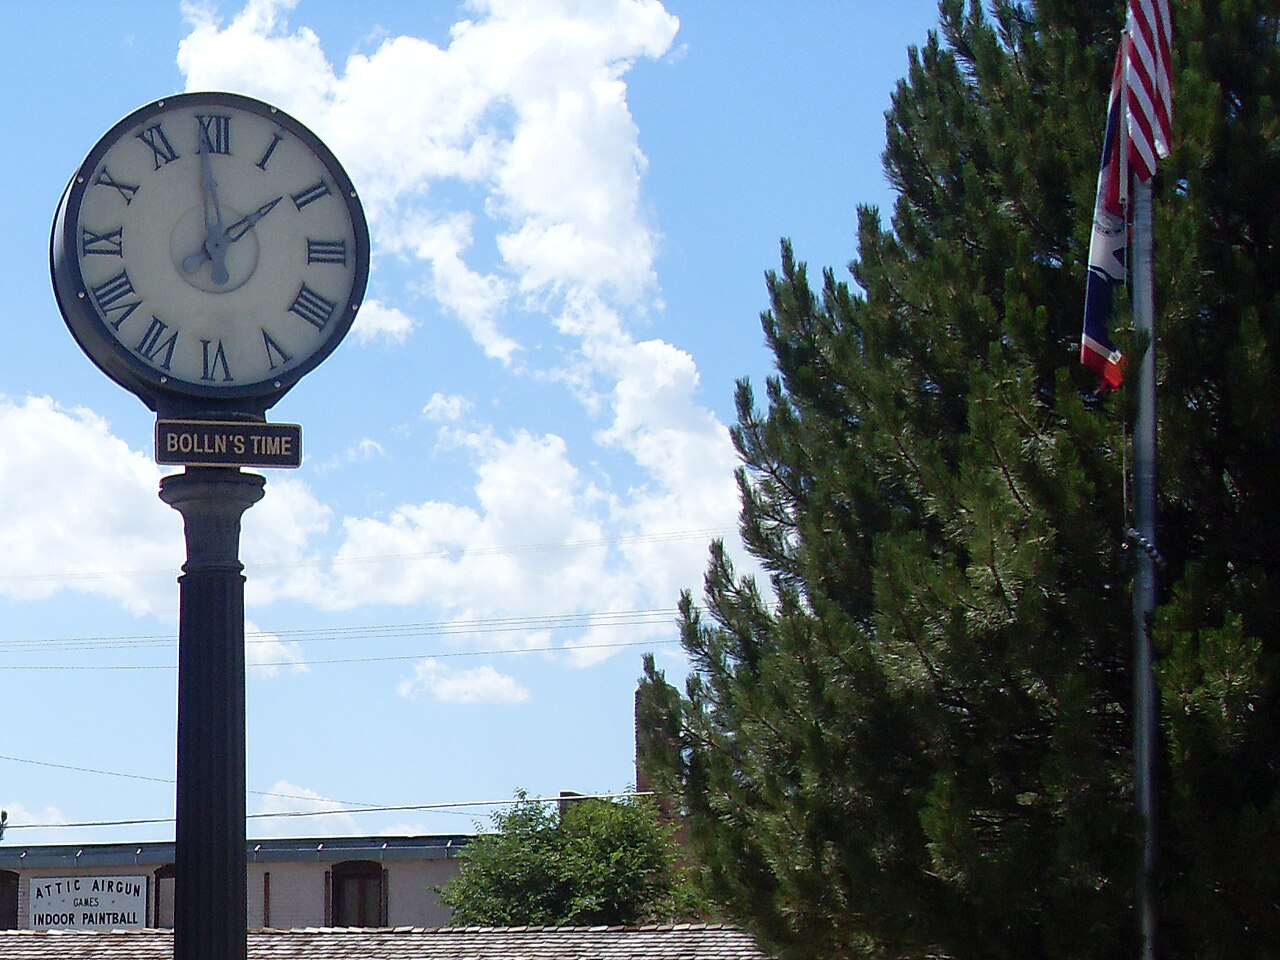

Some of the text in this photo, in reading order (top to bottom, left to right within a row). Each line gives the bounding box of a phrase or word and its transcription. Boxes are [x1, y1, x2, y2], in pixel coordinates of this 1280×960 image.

[136, 123, 180, 171] XI
[194, 114, 232, 156] XII
[256, 133, 284, 171] I
[95, 167, 140, 206] X
[289, 180, 332, 212] II
[82, 226, 123, 259] IX
[306, 238, 346, 267] III
[91, 268, 143, 332] VIII
[288, 282, 338, 332] IIII
[133, 315, 179, 371] VII
[199, 338, 234, 382] VI
[260, 328, 293, 370] V
[166, 432, 292, 456] BOLLN'S TIME
[36, 879, 141, 899] ATTIC AIRGUN
[73, 897, 99, 907] GAMES
[33, 912, 138, 926] INDOOR PAINTBALL
